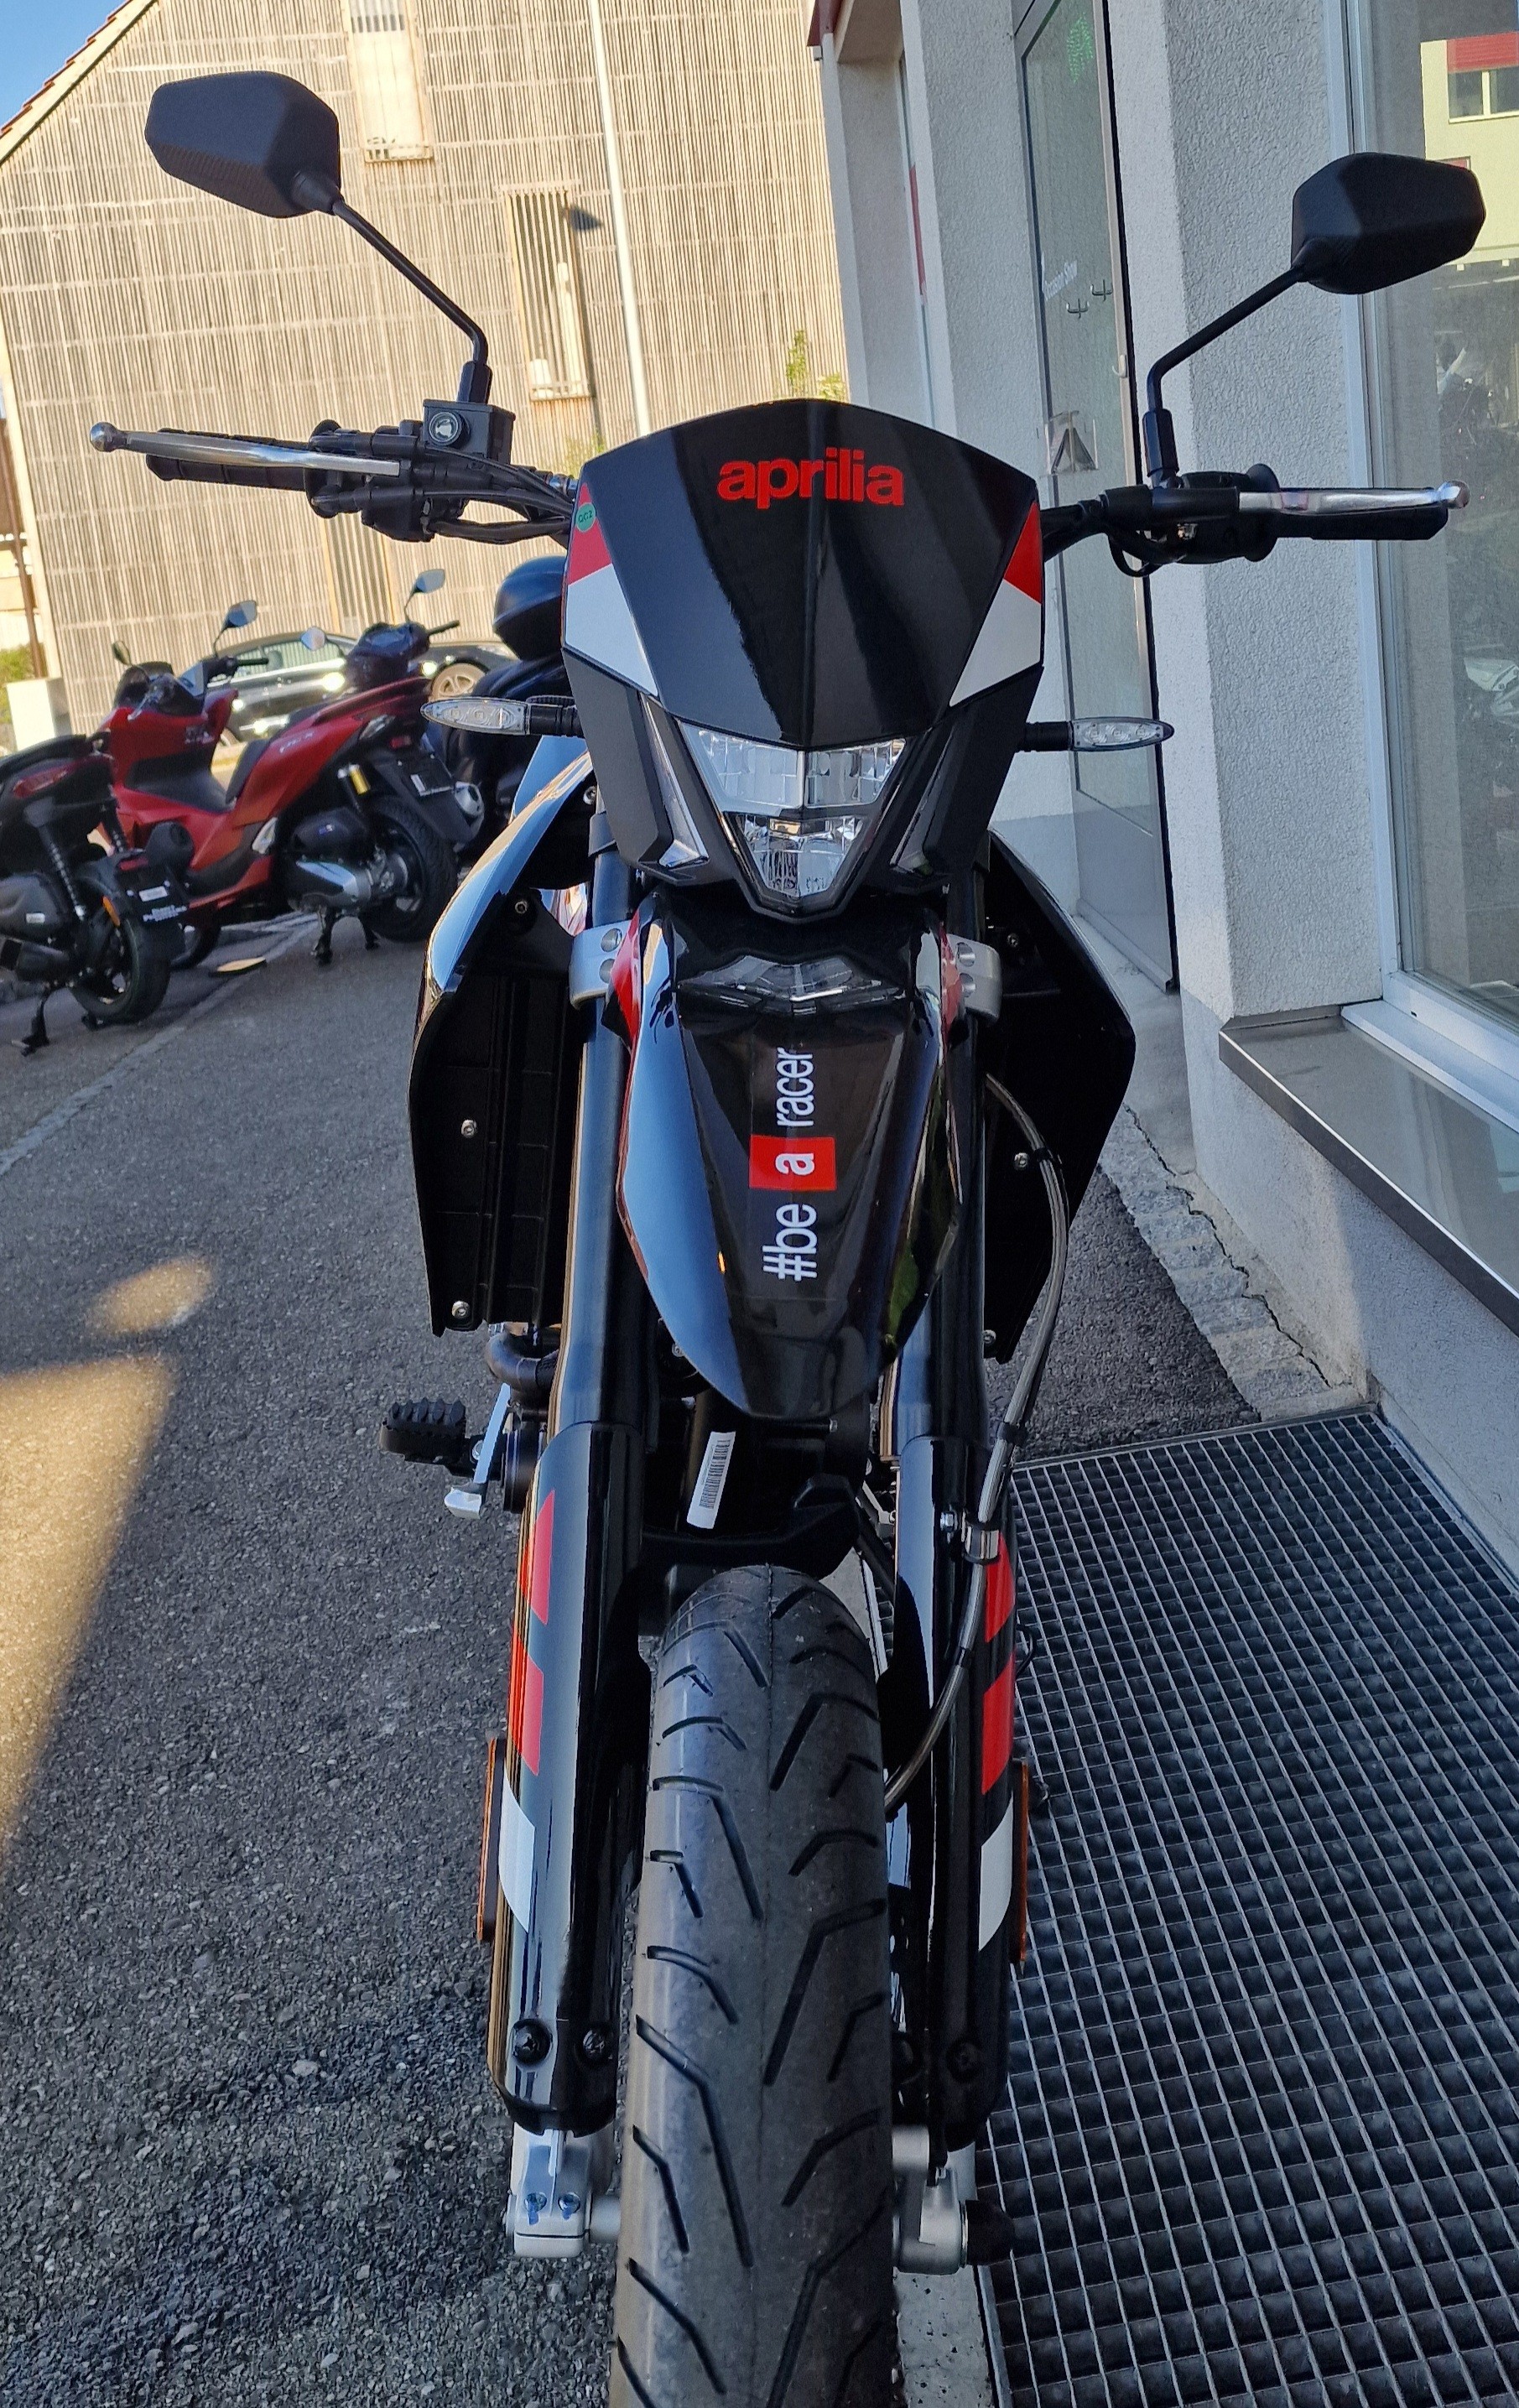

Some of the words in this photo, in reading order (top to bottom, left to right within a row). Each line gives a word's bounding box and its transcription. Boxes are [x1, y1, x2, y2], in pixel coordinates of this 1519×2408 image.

[717, 447, 904, 509] aprilia
[776, 1047, 814, 1127] racer
[775, 1152, 815, 1176] a
[762, 1203, 818, 1282] #be
